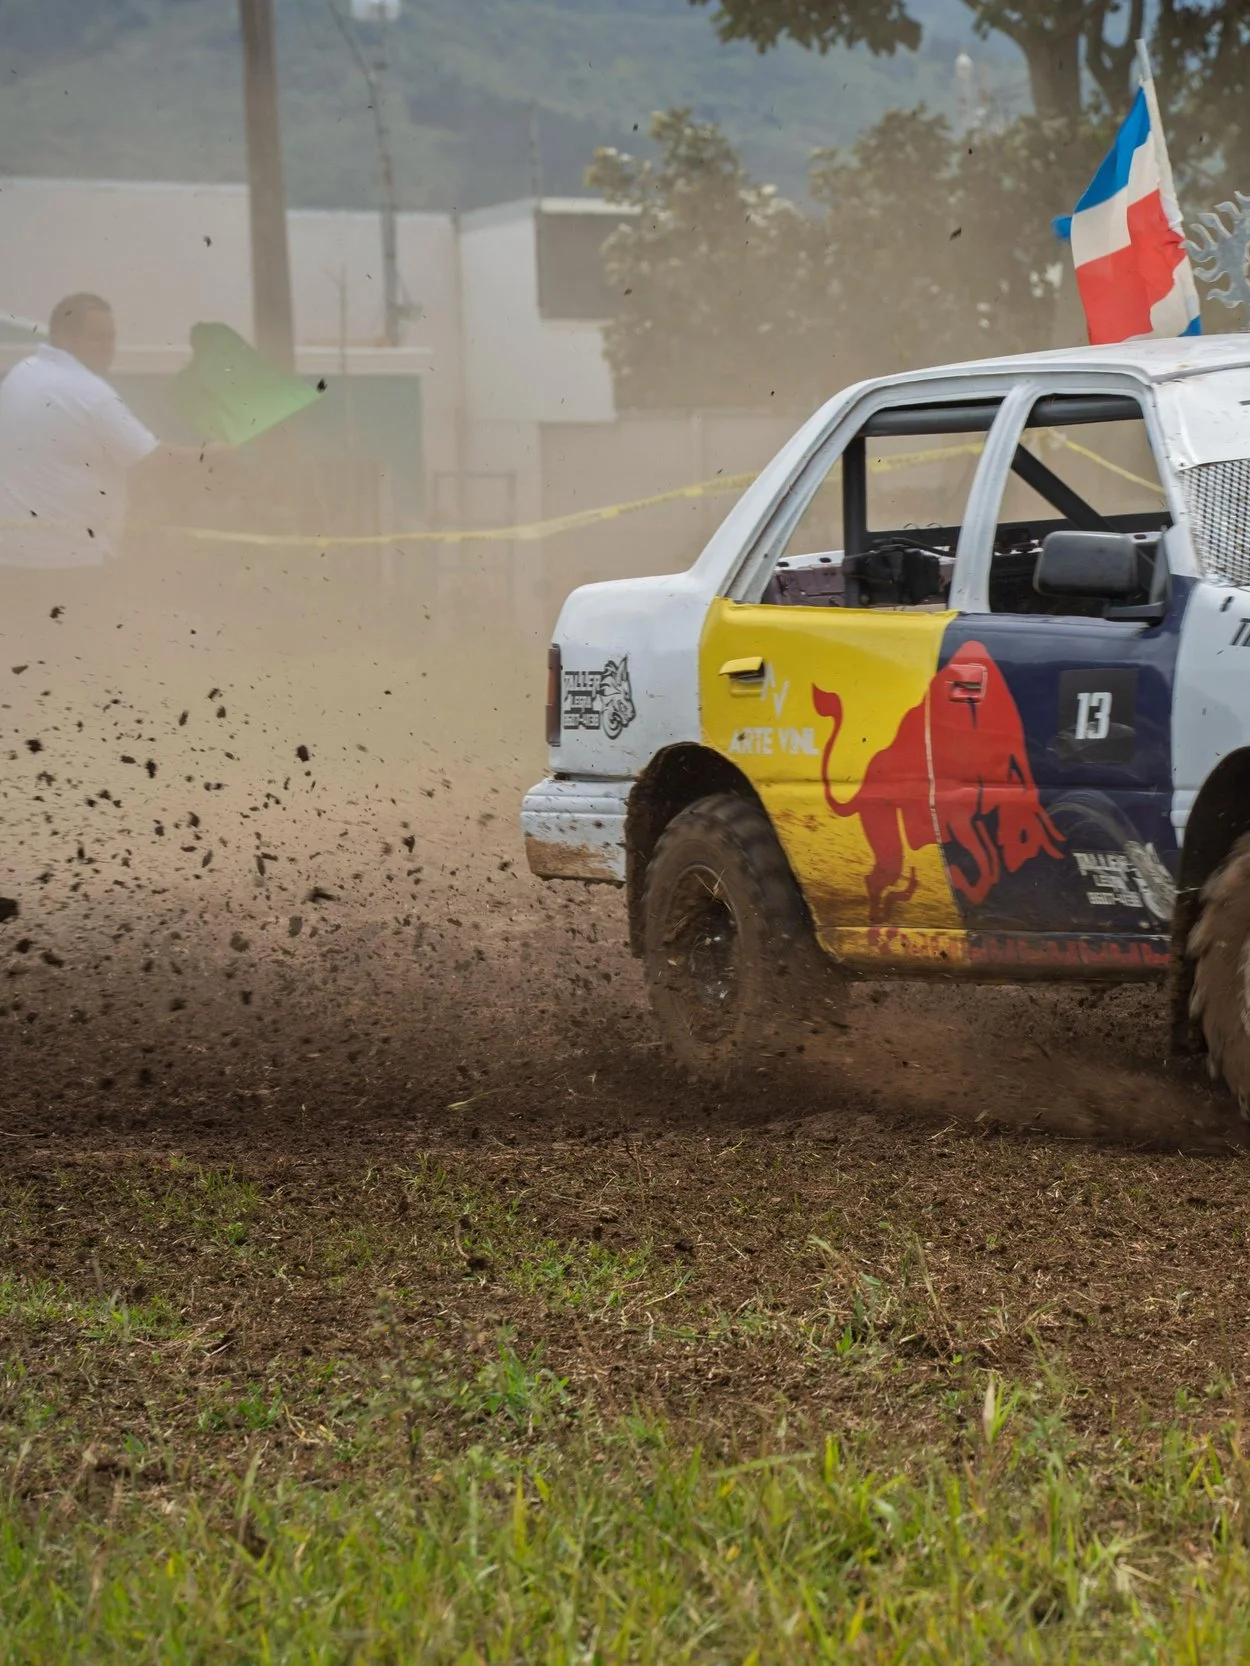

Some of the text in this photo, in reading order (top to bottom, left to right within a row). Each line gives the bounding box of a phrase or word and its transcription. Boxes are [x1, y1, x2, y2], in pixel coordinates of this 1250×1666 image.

[562, 671, 604, 693] TALLER
[1074, 691, 1113, 740] 13
[728, 726, 774, 756] ARTE
